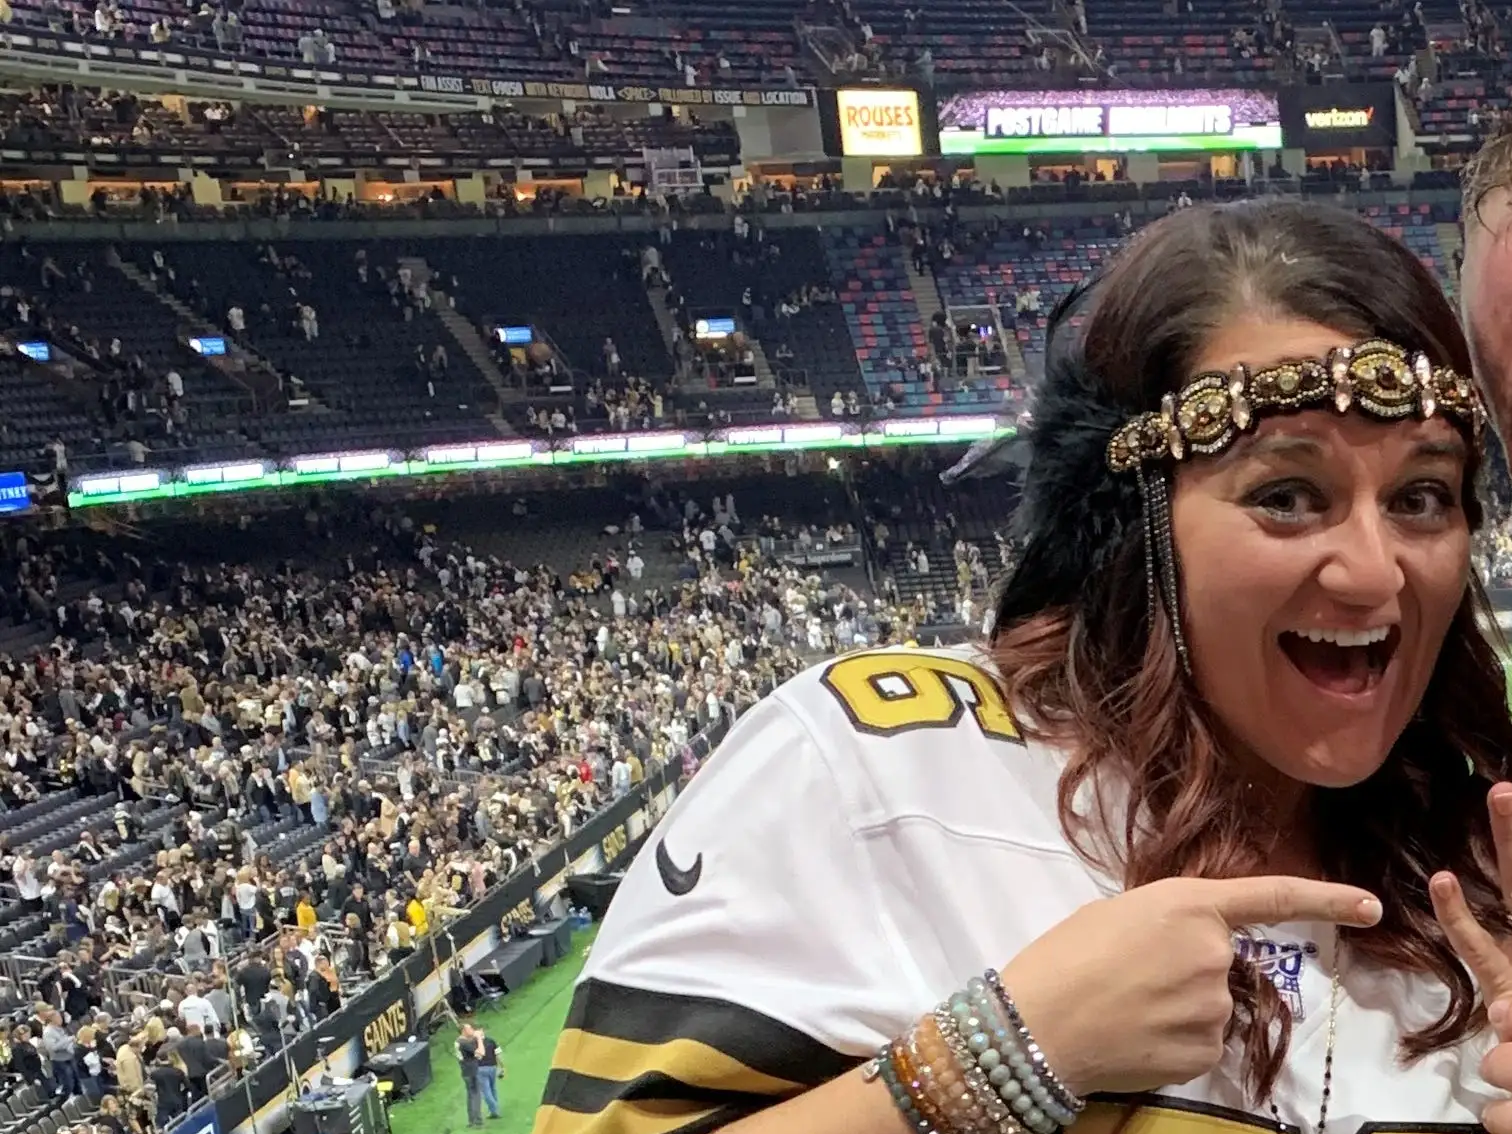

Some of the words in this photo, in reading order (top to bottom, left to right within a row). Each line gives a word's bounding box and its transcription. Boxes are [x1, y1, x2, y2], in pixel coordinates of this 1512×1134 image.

[846, 105, 914, 127] ROUSES
[1305, 108, 1369, 128] verizon
[364, 999, 407, 1059] SAINTS
